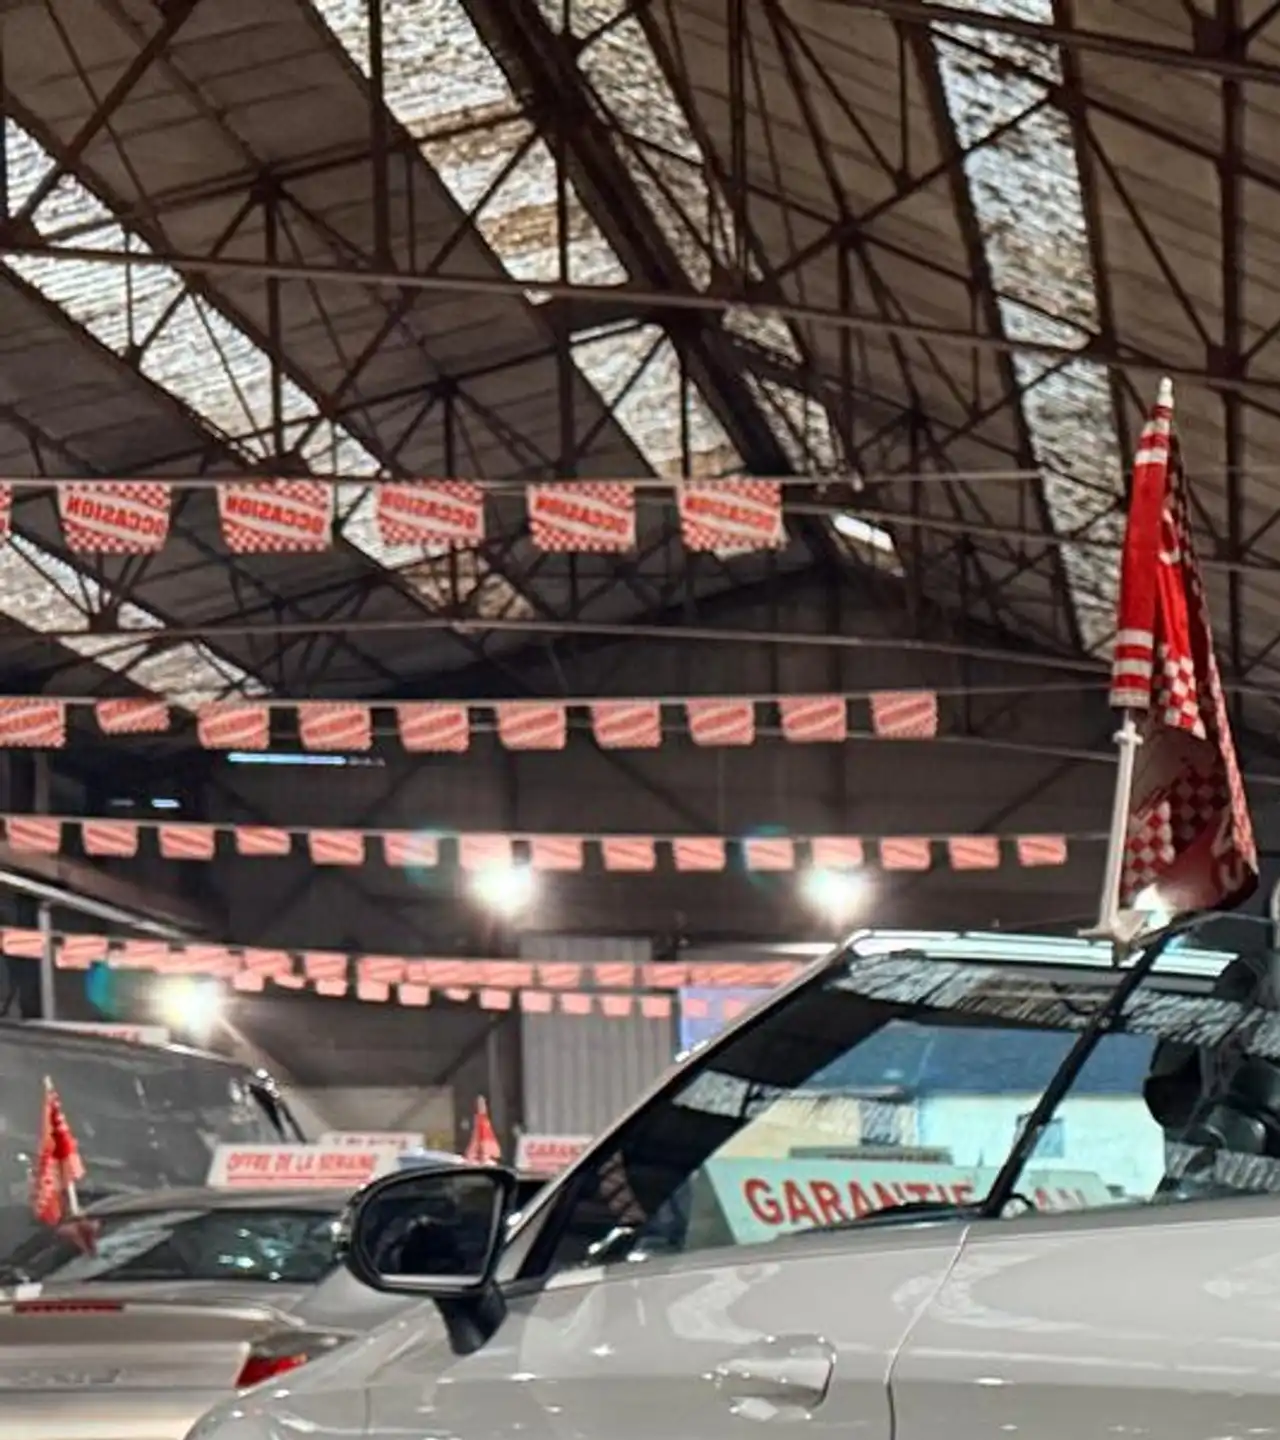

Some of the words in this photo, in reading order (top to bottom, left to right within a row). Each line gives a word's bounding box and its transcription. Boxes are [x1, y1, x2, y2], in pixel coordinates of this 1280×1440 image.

[227, 1152, 270, 1171] OFFRE
[274, 1152, 292, 1171] DE
[295, 1152, 314, 1171] LA
[319, 1152, 376, 1171] SEMAINE
